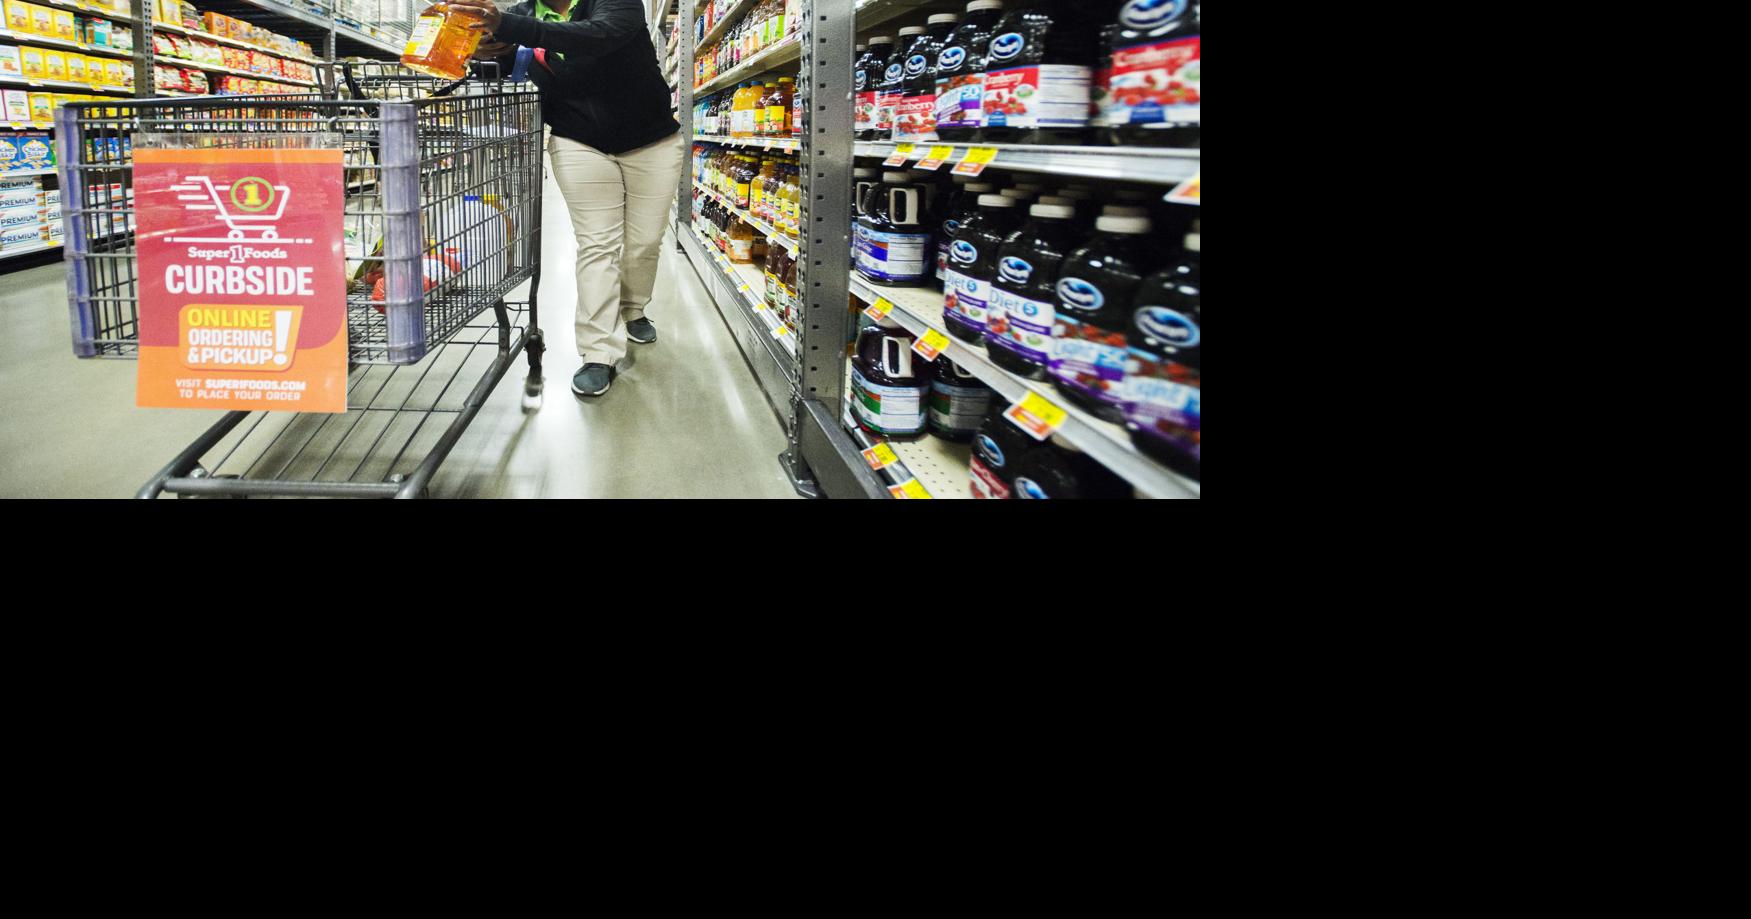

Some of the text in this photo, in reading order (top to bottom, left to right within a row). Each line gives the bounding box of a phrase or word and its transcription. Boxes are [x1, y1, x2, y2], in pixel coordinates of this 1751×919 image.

[0, 198, 36, 206] PREMIUM
[1, 215, 37, 224] PREMIUM
[2, 232, 39, 242] PREMIUM
[165, 264, 314, 295] CURBSIDE
[991, 288, 1020, 313] Diet
[188, 309, 272, 327] ONLINE
[188, 329, 272, 346] ORDERING
[176, 379, 200, 388] VISIT
[180, 389, 301, 400] TO PLACE YOUR ORDER
